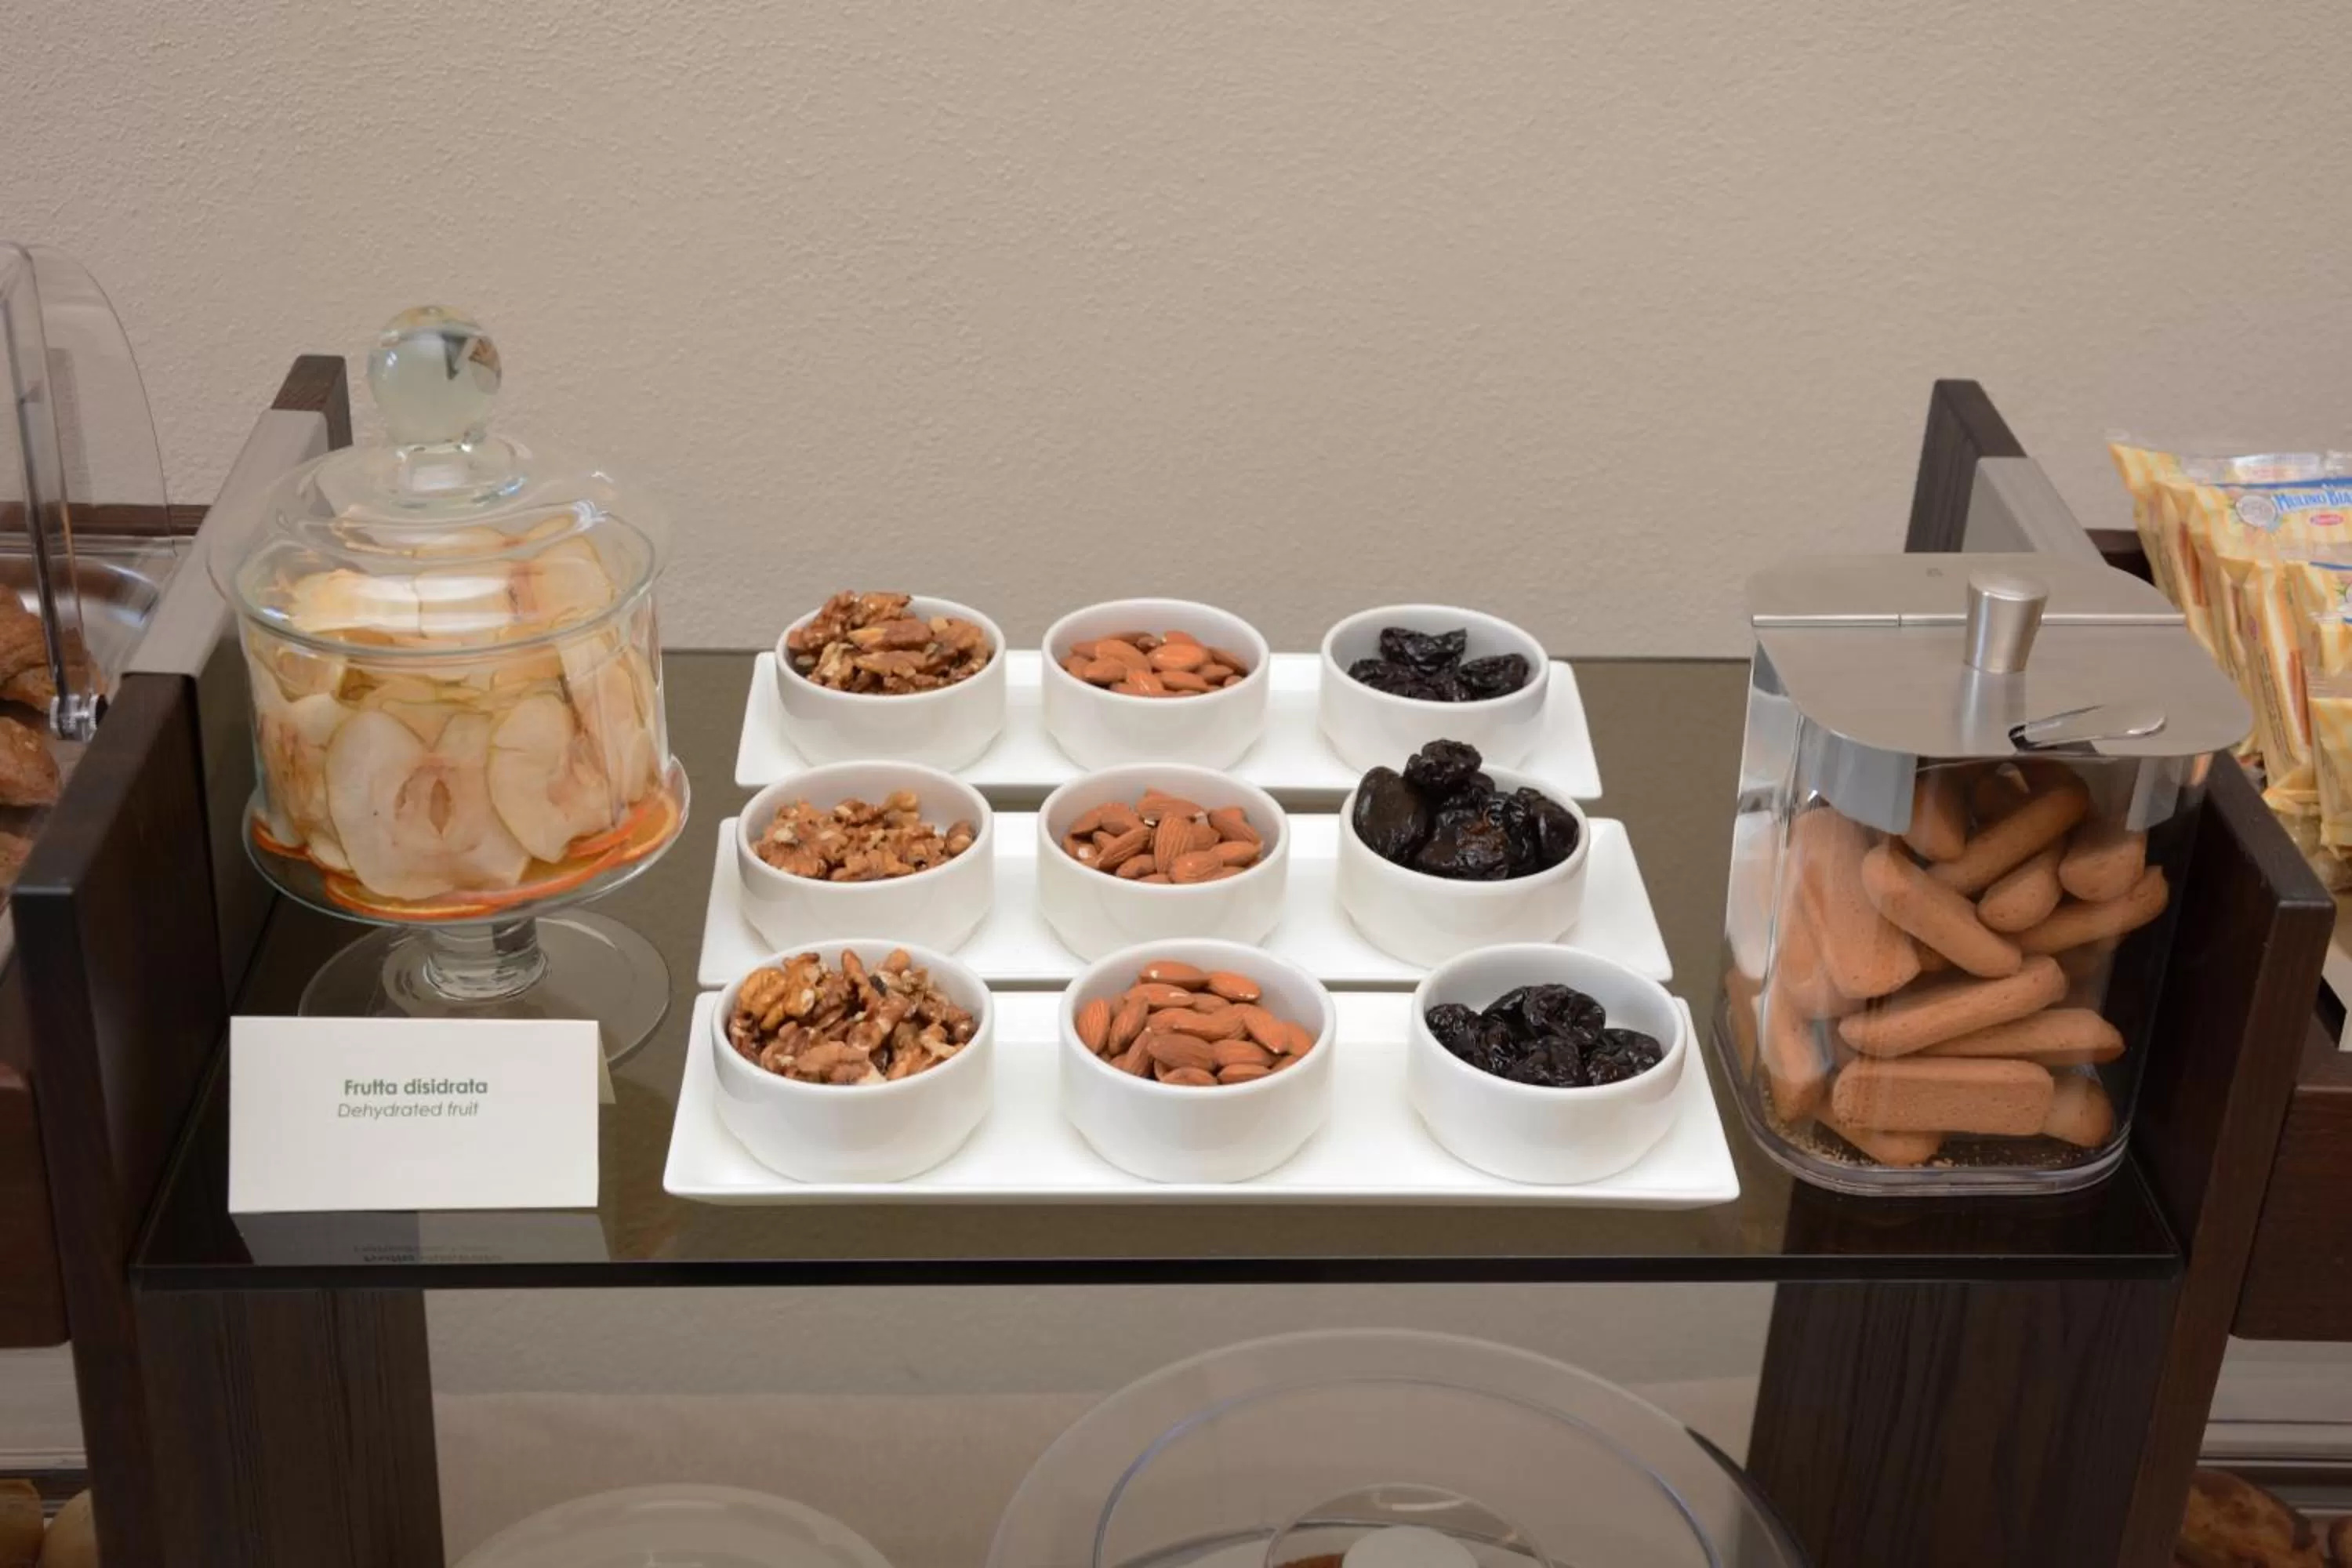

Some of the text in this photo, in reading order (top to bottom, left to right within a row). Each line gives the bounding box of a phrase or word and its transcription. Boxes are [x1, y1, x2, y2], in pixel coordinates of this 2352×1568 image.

[343, 1078, 488, 1095] Frutta disidrata
[337, 1100, 480, 1120] Dehydrated fruit
